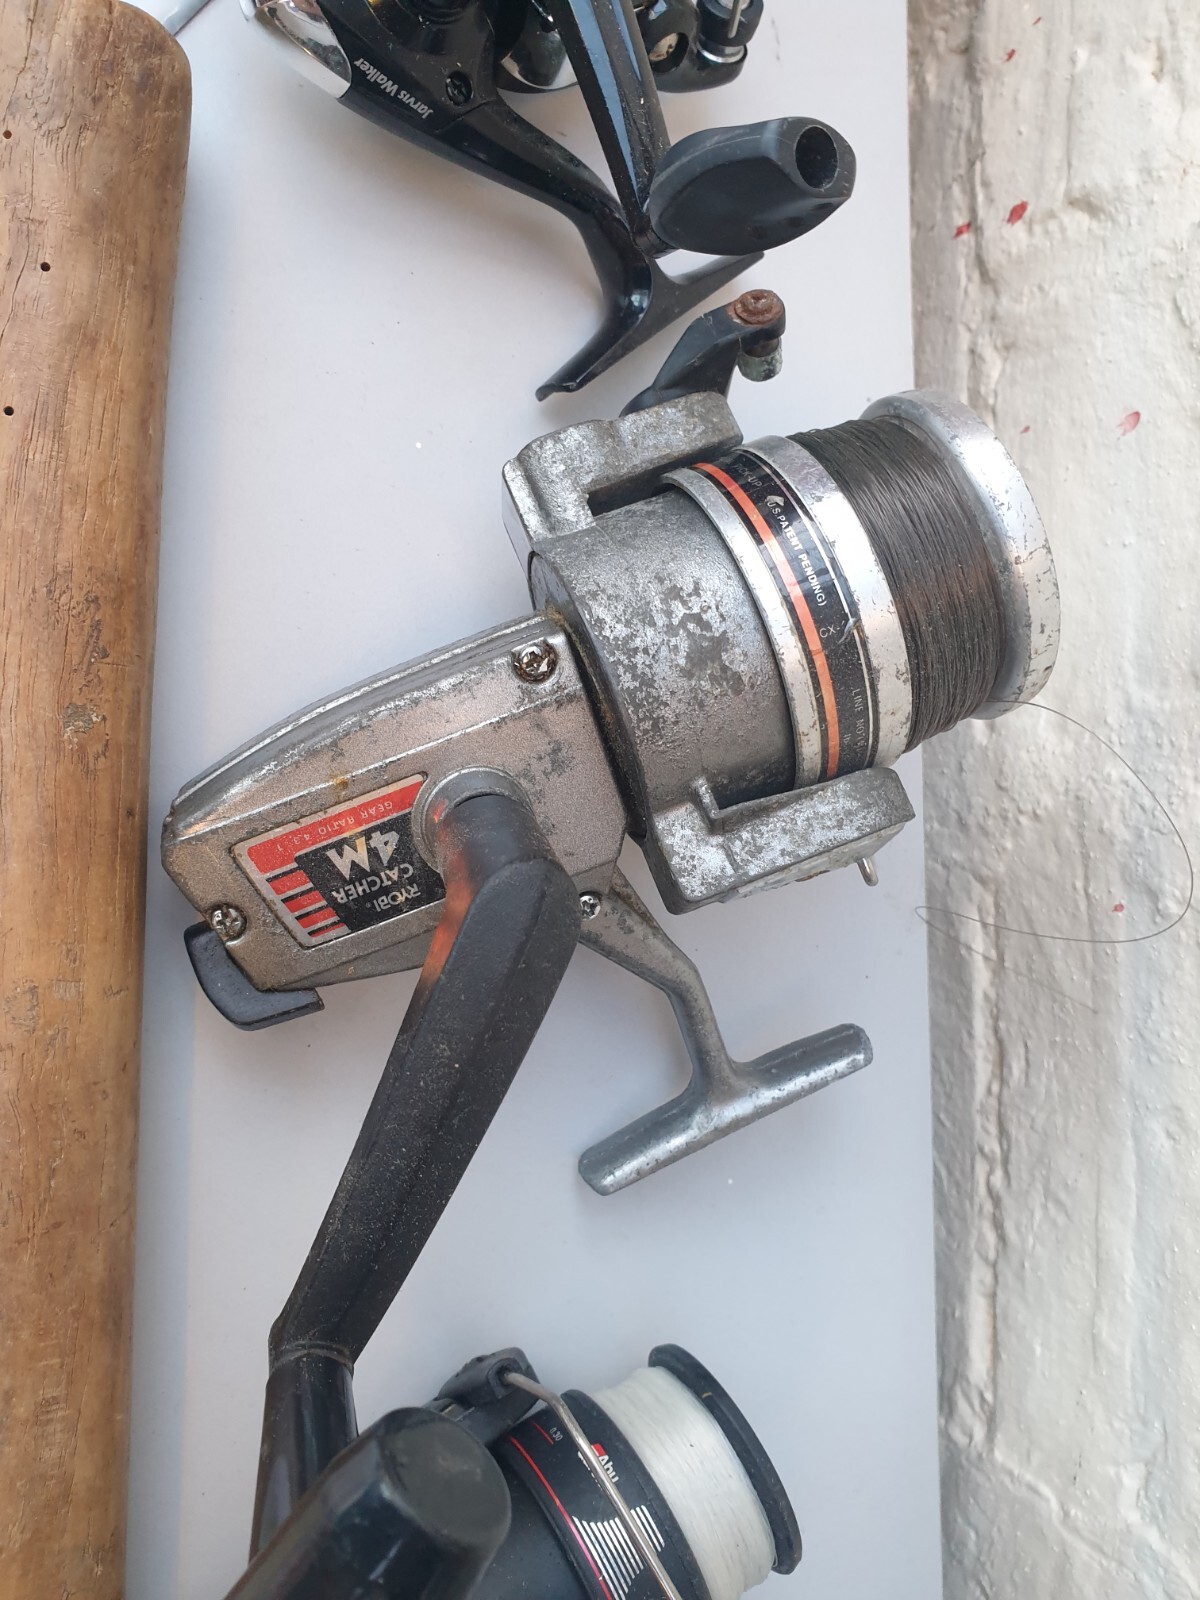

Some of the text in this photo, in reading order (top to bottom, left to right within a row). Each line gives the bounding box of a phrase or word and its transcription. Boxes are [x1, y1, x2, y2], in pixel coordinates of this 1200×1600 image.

[353, 57, 434, 119] Jarvis Walker
[798, 552, 828, 607] PENDING)
[318, 816, 355, 835] RATIO
[359, 801, 393, 820] GEAR
[326, 830, 400, 881] 4M
[331, 863, 414, 904] CATCHER
[374, 882, 421, 912] RYOBI
